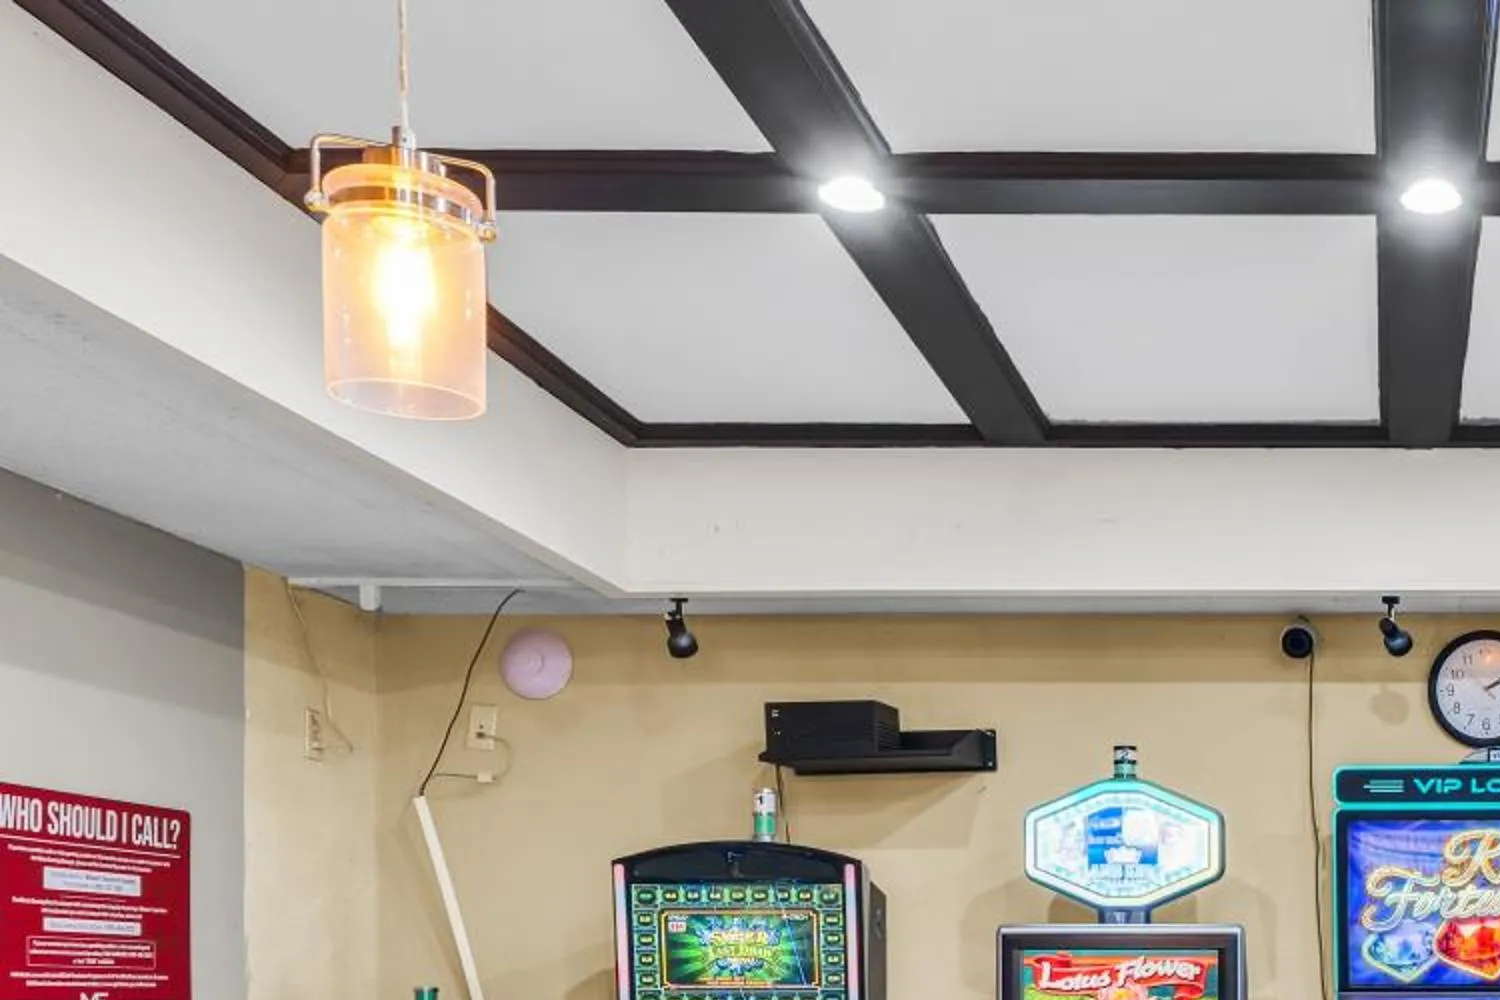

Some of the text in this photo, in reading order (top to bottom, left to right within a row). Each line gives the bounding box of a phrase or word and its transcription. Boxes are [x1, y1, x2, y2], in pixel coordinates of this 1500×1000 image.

[1445, 683, 1455, 697] 9
[1453, 702, 1460, 714] 8
[1466, 713, 1475, 726] 7
[1481, 718, 1491, 731] 6
[1414, 777, 1462, 794] VIP
[0, 793, 181, 850] WHO SHOULD I CALL?
[1039, 955, 1201, 990] Lotus Flower
